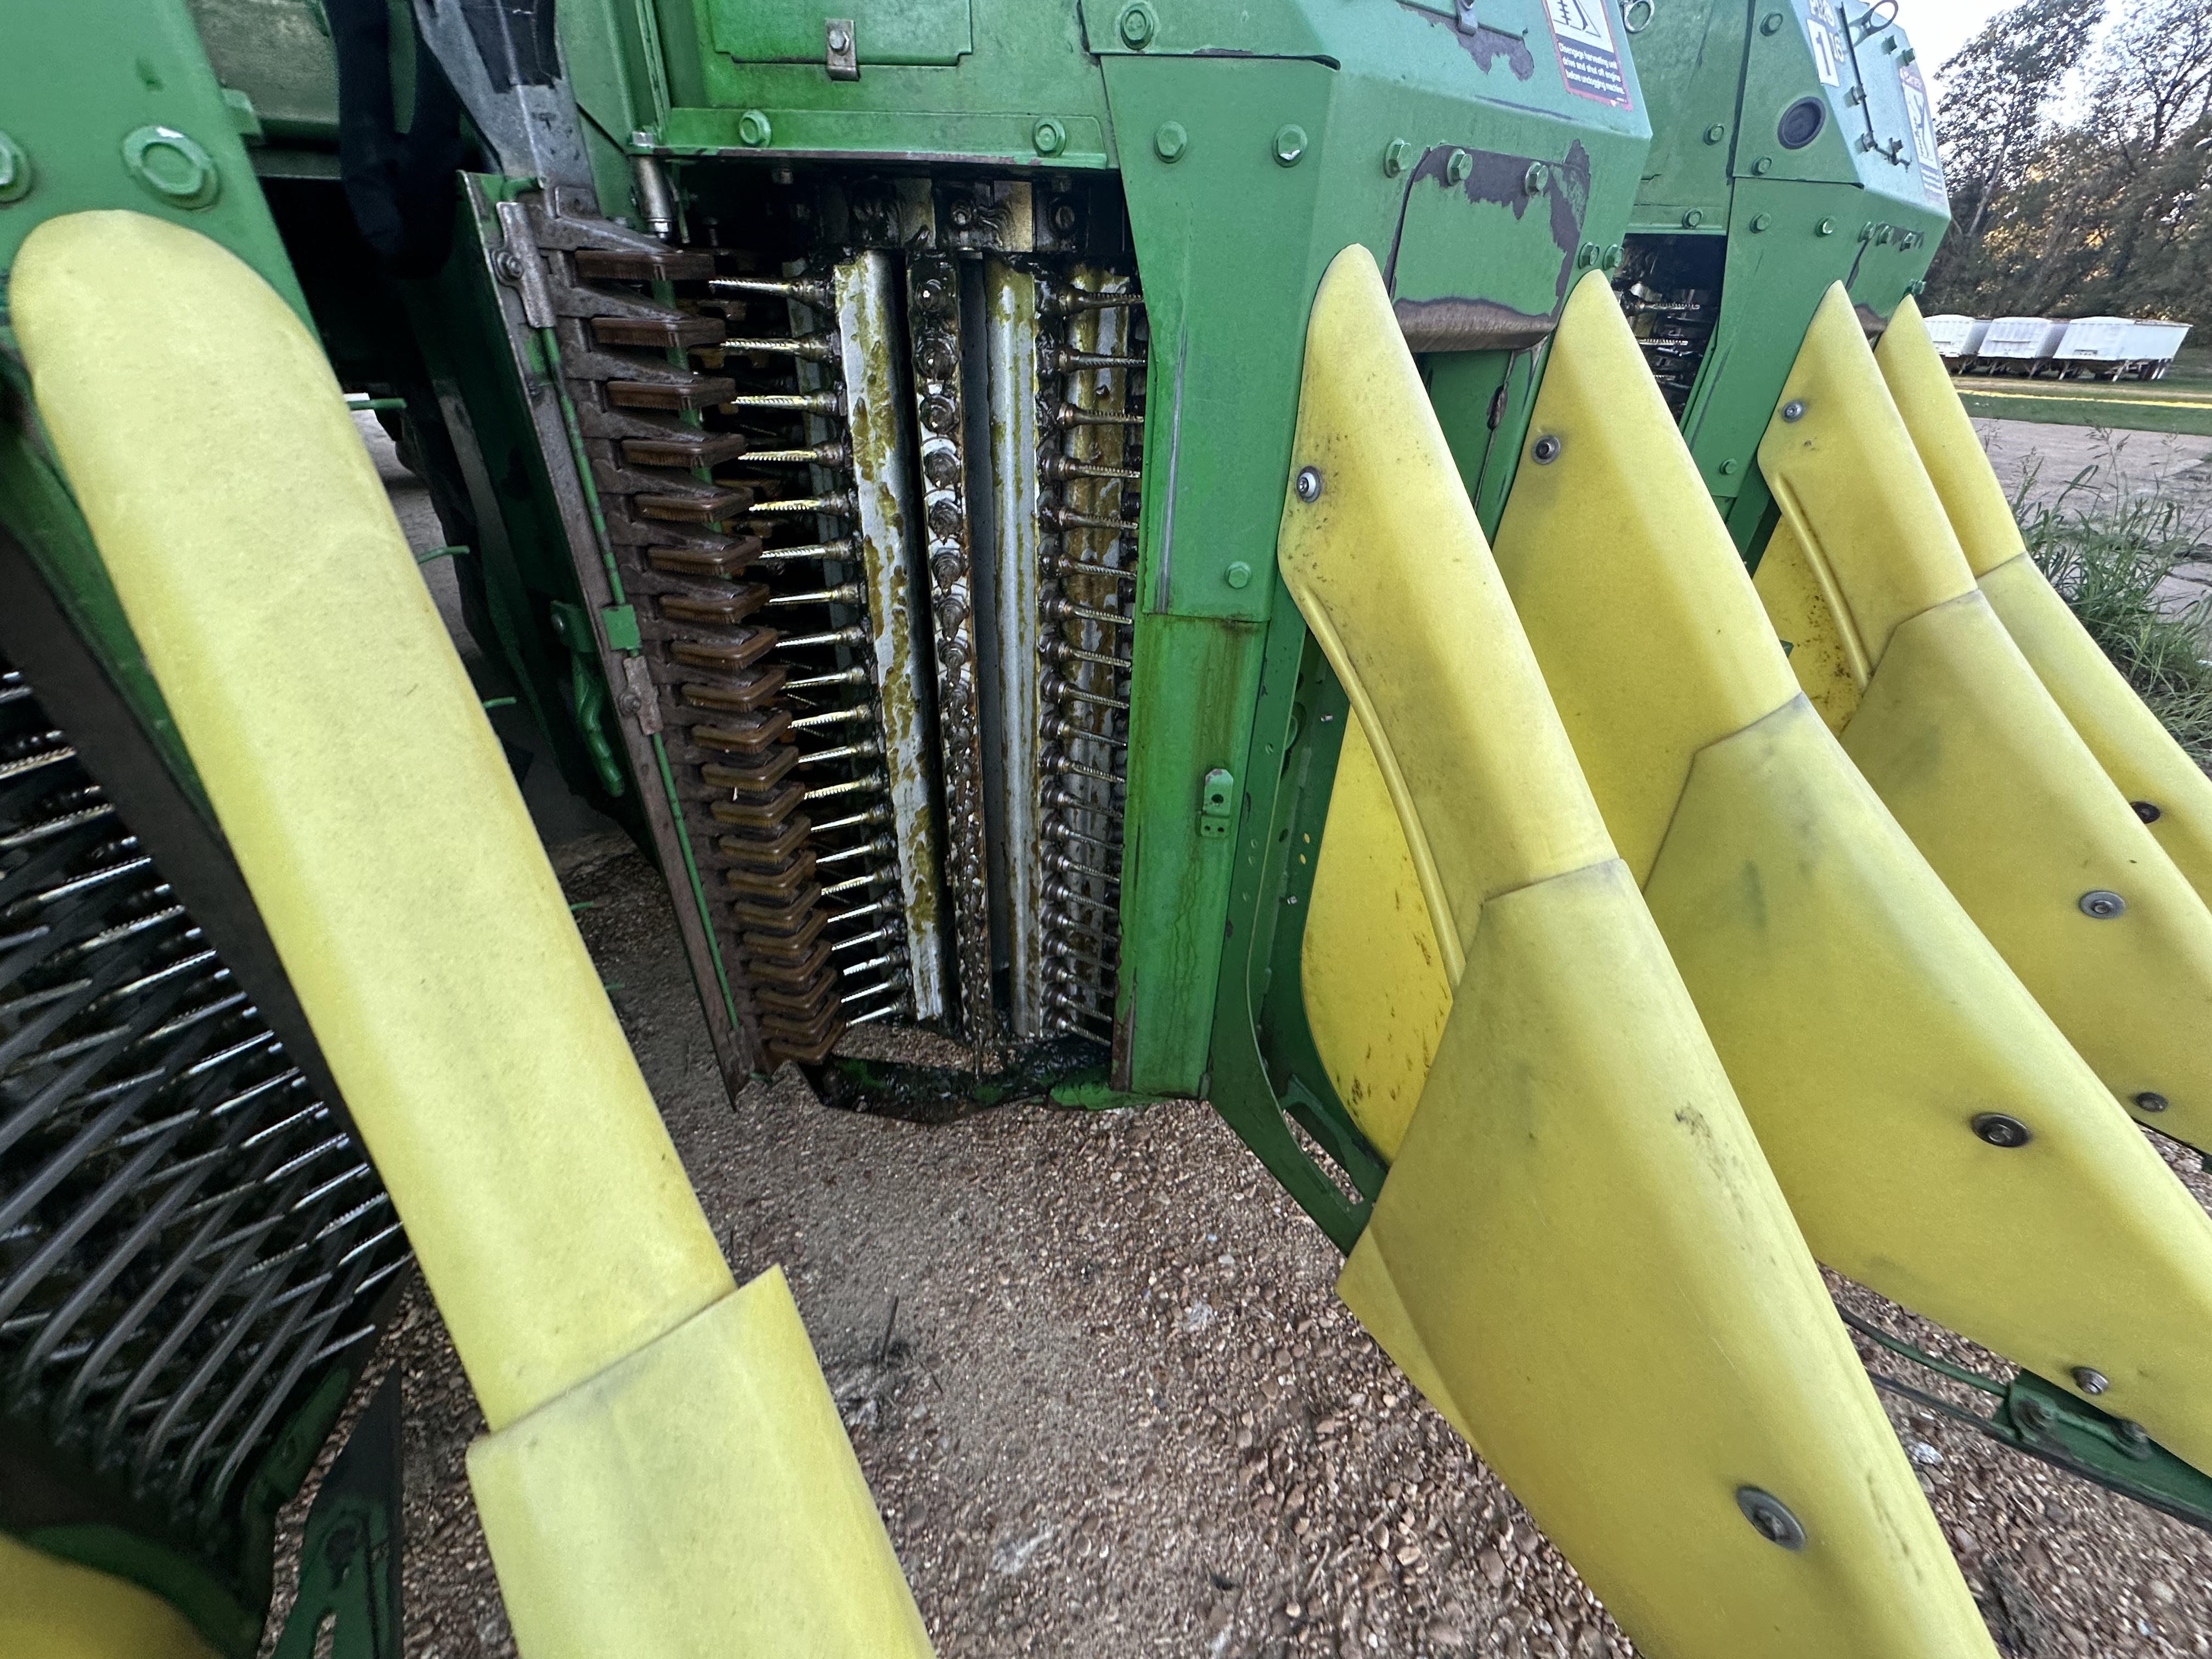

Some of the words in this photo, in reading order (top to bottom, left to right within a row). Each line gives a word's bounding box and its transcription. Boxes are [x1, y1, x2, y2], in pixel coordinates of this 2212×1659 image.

[1558, 42, 1584, 60] Disengage
[1584, 50, 1609, 69] harvesting
[1608, 60, 1618, 69] unit
[1562, 57, 1576, 67] drive
[1576, 61, 1585, 71] and
[1586, 64, 1598, 74] shut
[1605, 71, 1621, 82] engine
[1565, 69, 1581, 81] before
[1581, 76, 1606, 91] unclogging
